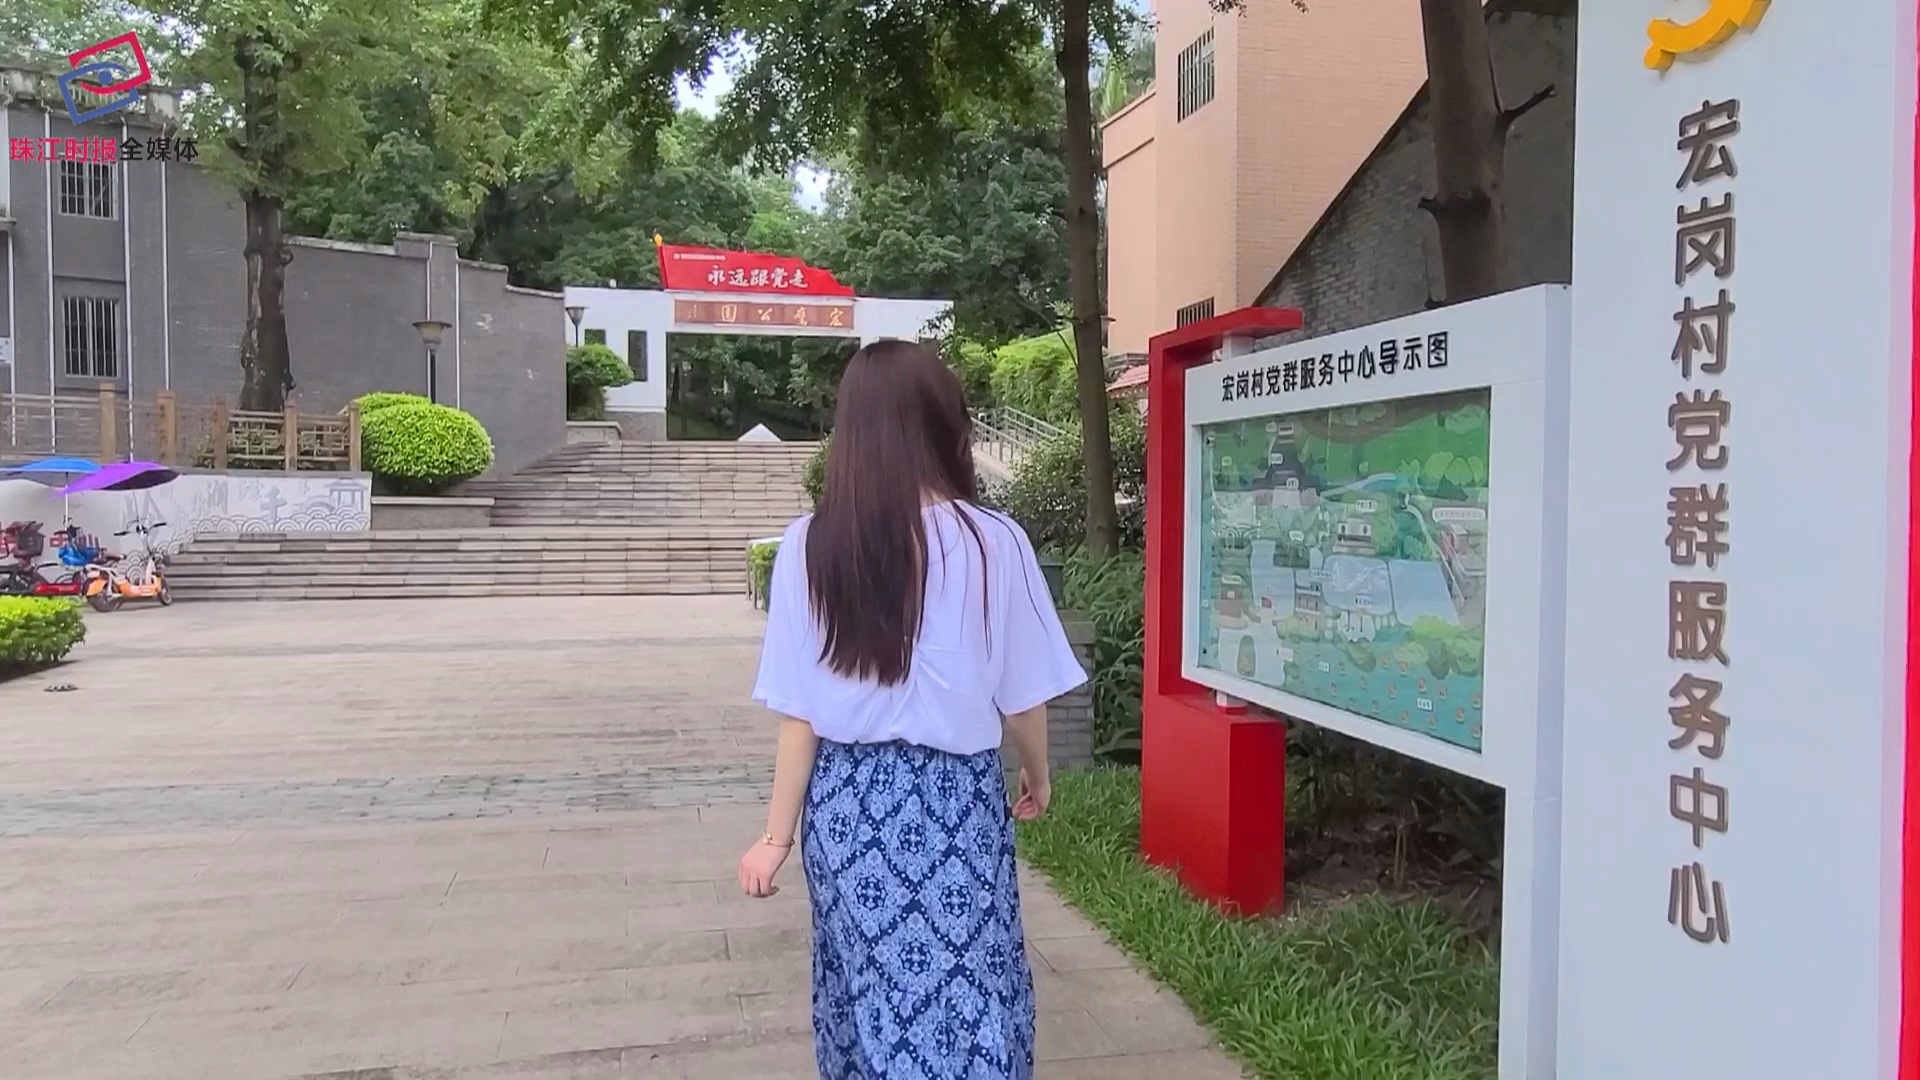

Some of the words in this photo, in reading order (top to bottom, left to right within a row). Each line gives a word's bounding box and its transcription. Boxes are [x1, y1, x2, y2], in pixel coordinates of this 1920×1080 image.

[707, 265, 808, 289] 永远跟党走
[1221, 331, 1449, 402] 宏岗村党群服务中心导示图
[1664, 97, 1741, 945] 宏岗村党群服务中心
